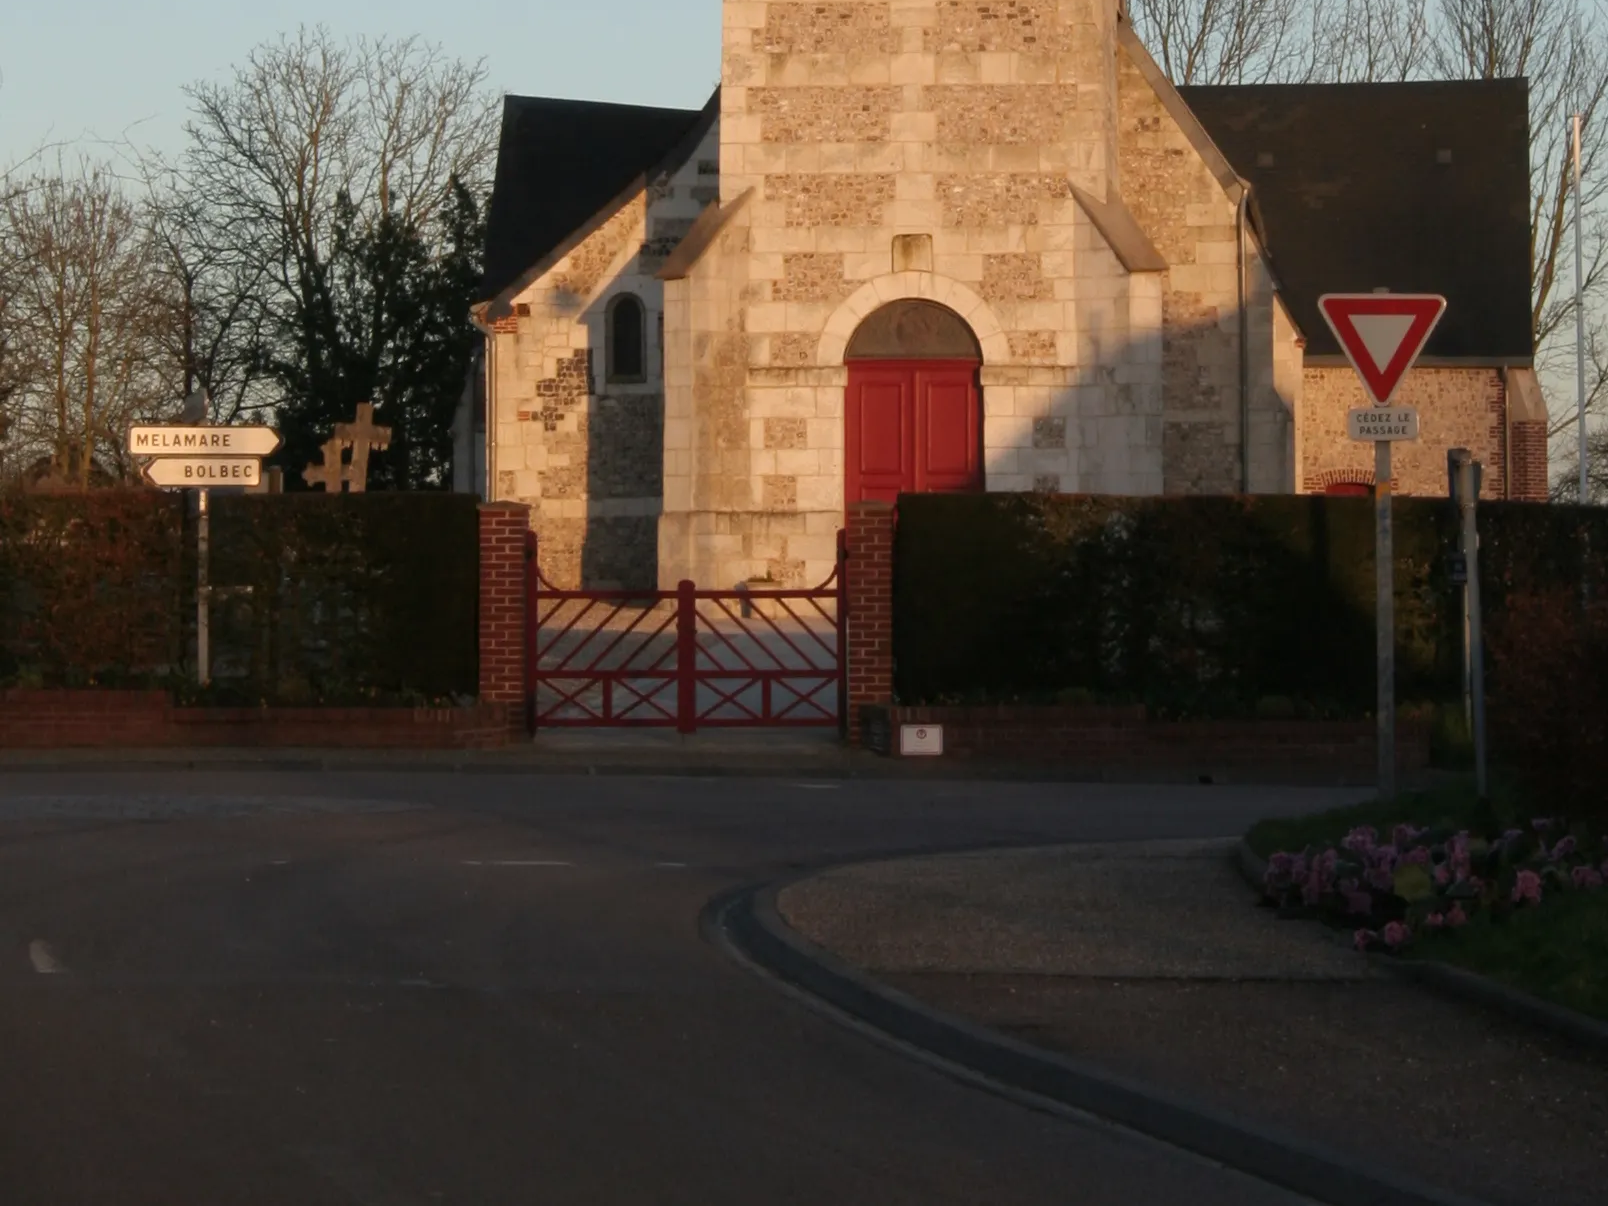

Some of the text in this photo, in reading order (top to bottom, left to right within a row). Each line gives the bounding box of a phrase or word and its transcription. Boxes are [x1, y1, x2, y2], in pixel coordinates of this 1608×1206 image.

[1356, 410, 1410, 423] CÉDEZ LE
[1359, 426, 1407, 435] PASSAGE
[136, 433, 231, 447] MELAMARE
[184, 465, 253, 478] BOLBEC
